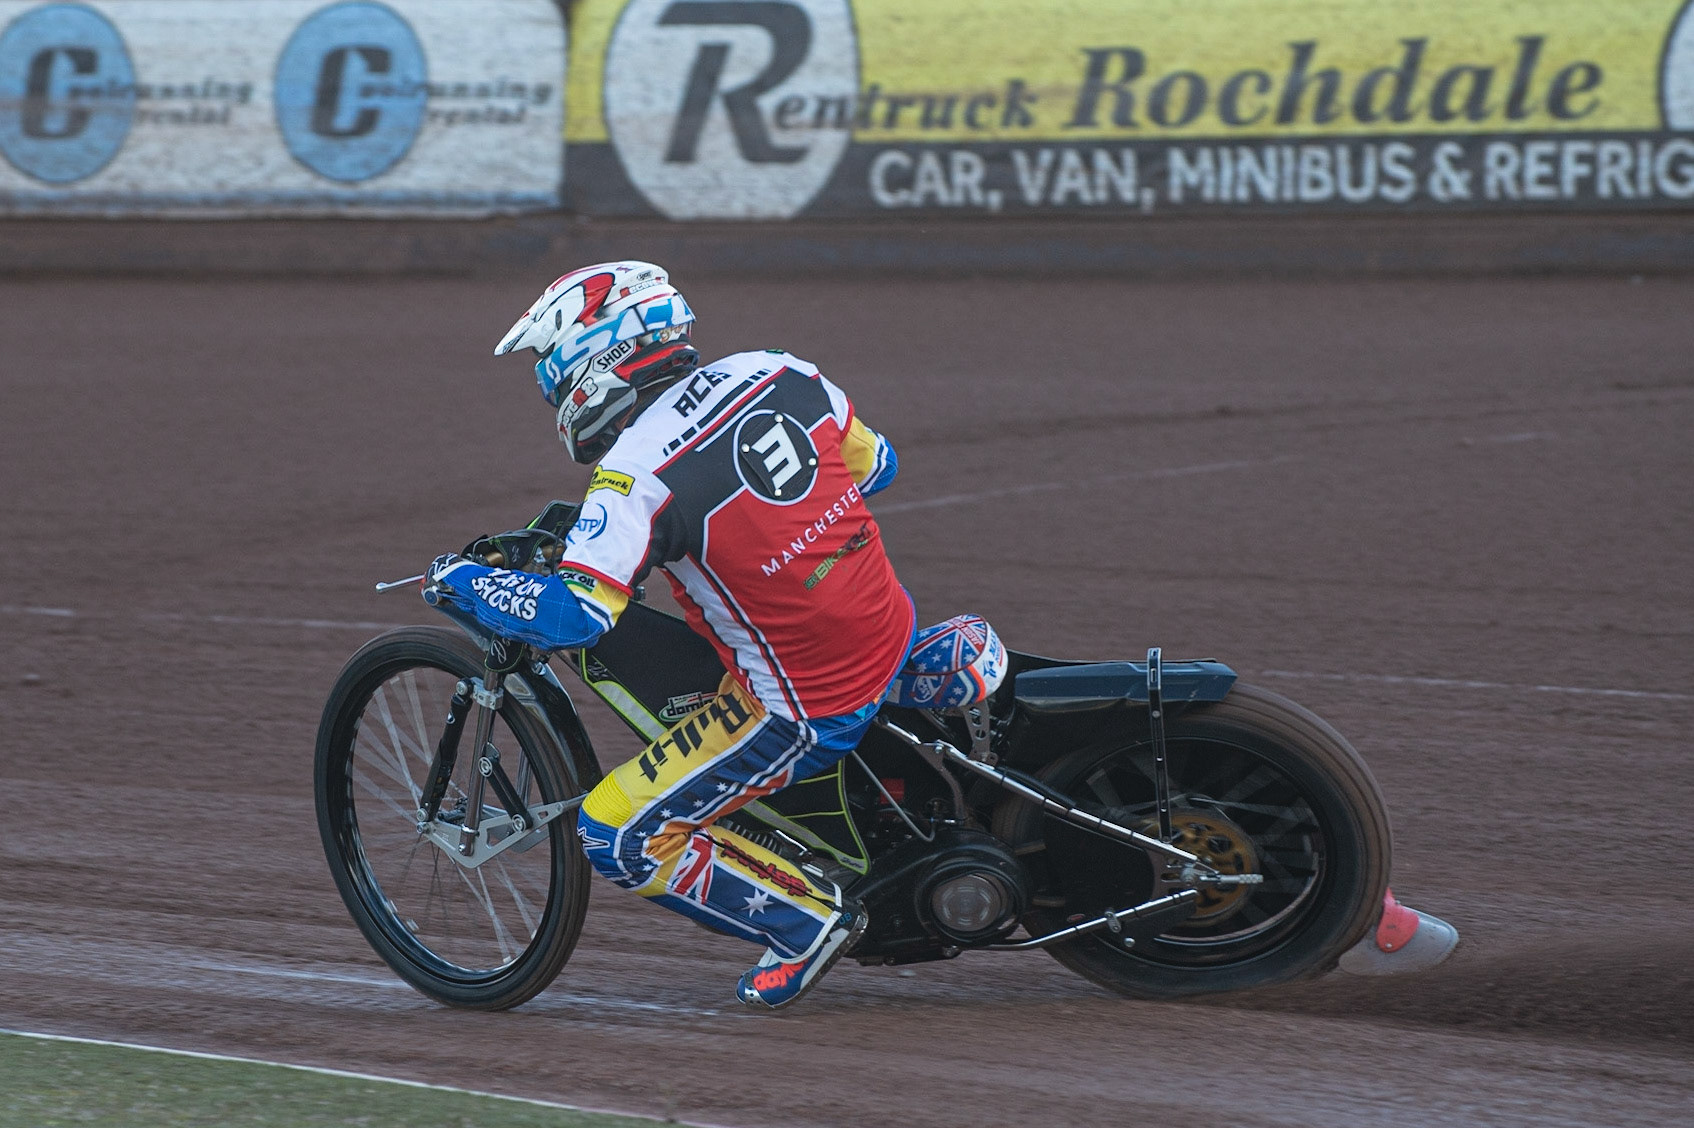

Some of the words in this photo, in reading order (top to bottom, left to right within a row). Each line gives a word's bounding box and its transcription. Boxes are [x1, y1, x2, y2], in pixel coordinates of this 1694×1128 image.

[655, 0, 1037, 164] Rentruck
[1060, 33, 1604, 129] Rochdale
[868, 149, 1003, 212] CAR,
[1011, 147, 1154, 213] VAN,
[1168, 142, 1415, 203] MINIBUS
[1428, 141, 1472, 201] &
[597, 340, 632, 371] SHOEI
[471, 577, 537, 620] SHOCKS
[578, 575, 595, 588] OIL
[753, 958, 809, 993] dayto
